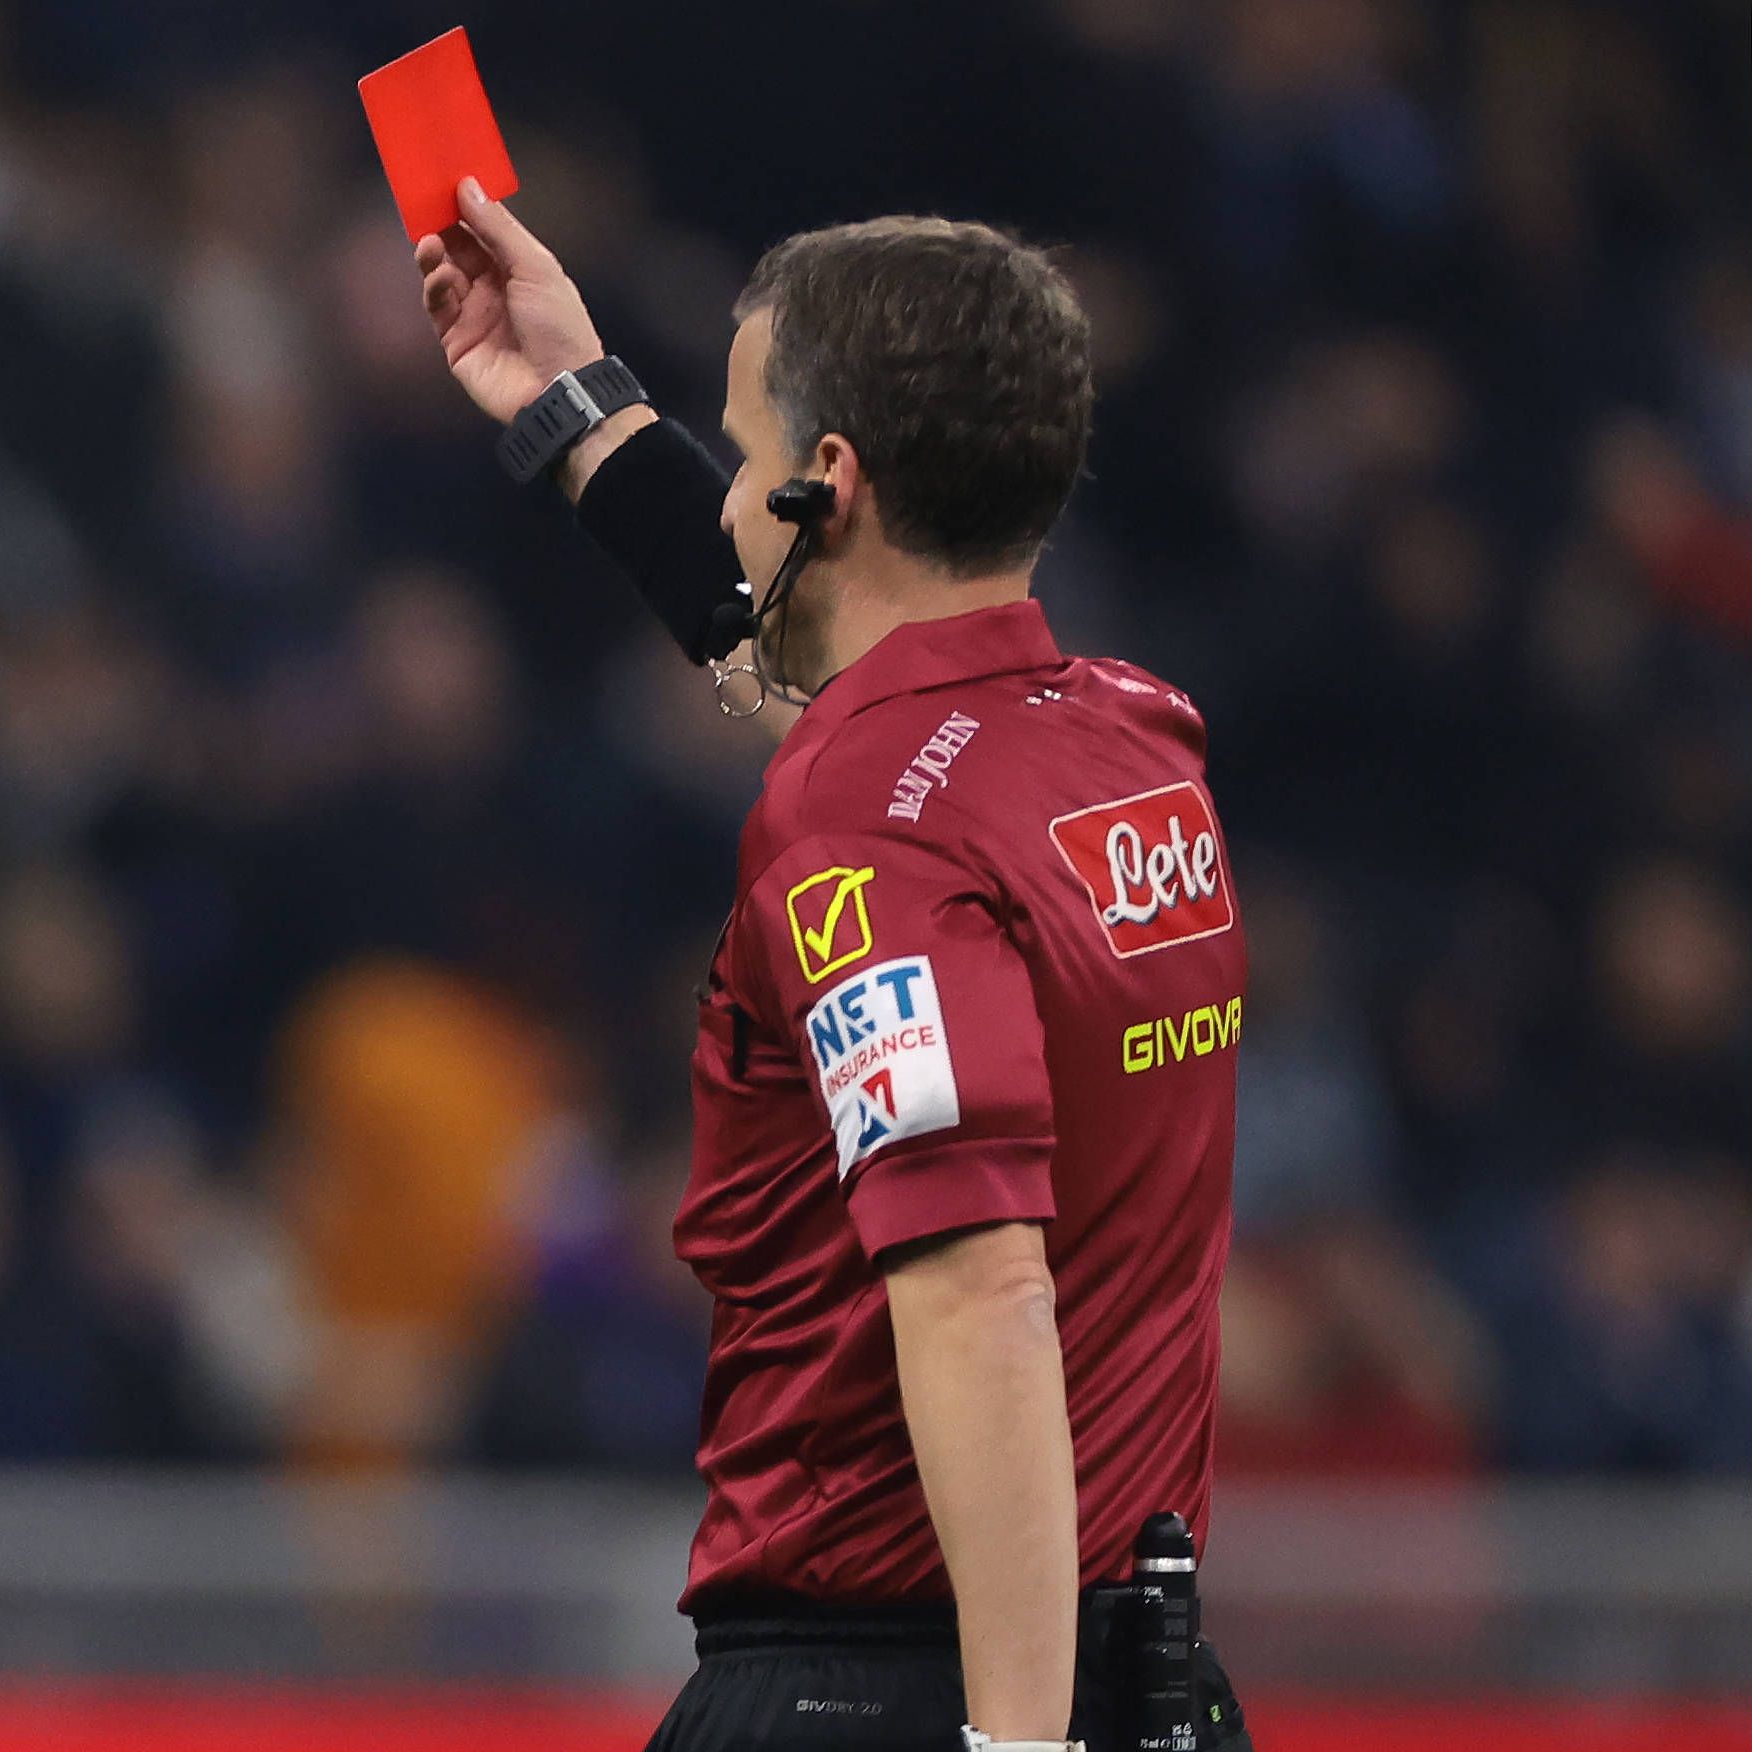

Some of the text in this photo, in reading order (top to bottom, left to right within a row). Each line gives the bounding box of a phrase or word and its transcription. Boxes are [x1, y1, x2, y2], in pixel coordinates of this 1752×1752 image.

[911, 710, 980, 789] JOHN
[1103, 815, 1216, 925] Lete
[811, 966, 921, 1070] NET
[1123, 996, 1241, 1074] GIVOVA
[826, 1025, 937, 1097] INSURANCE
